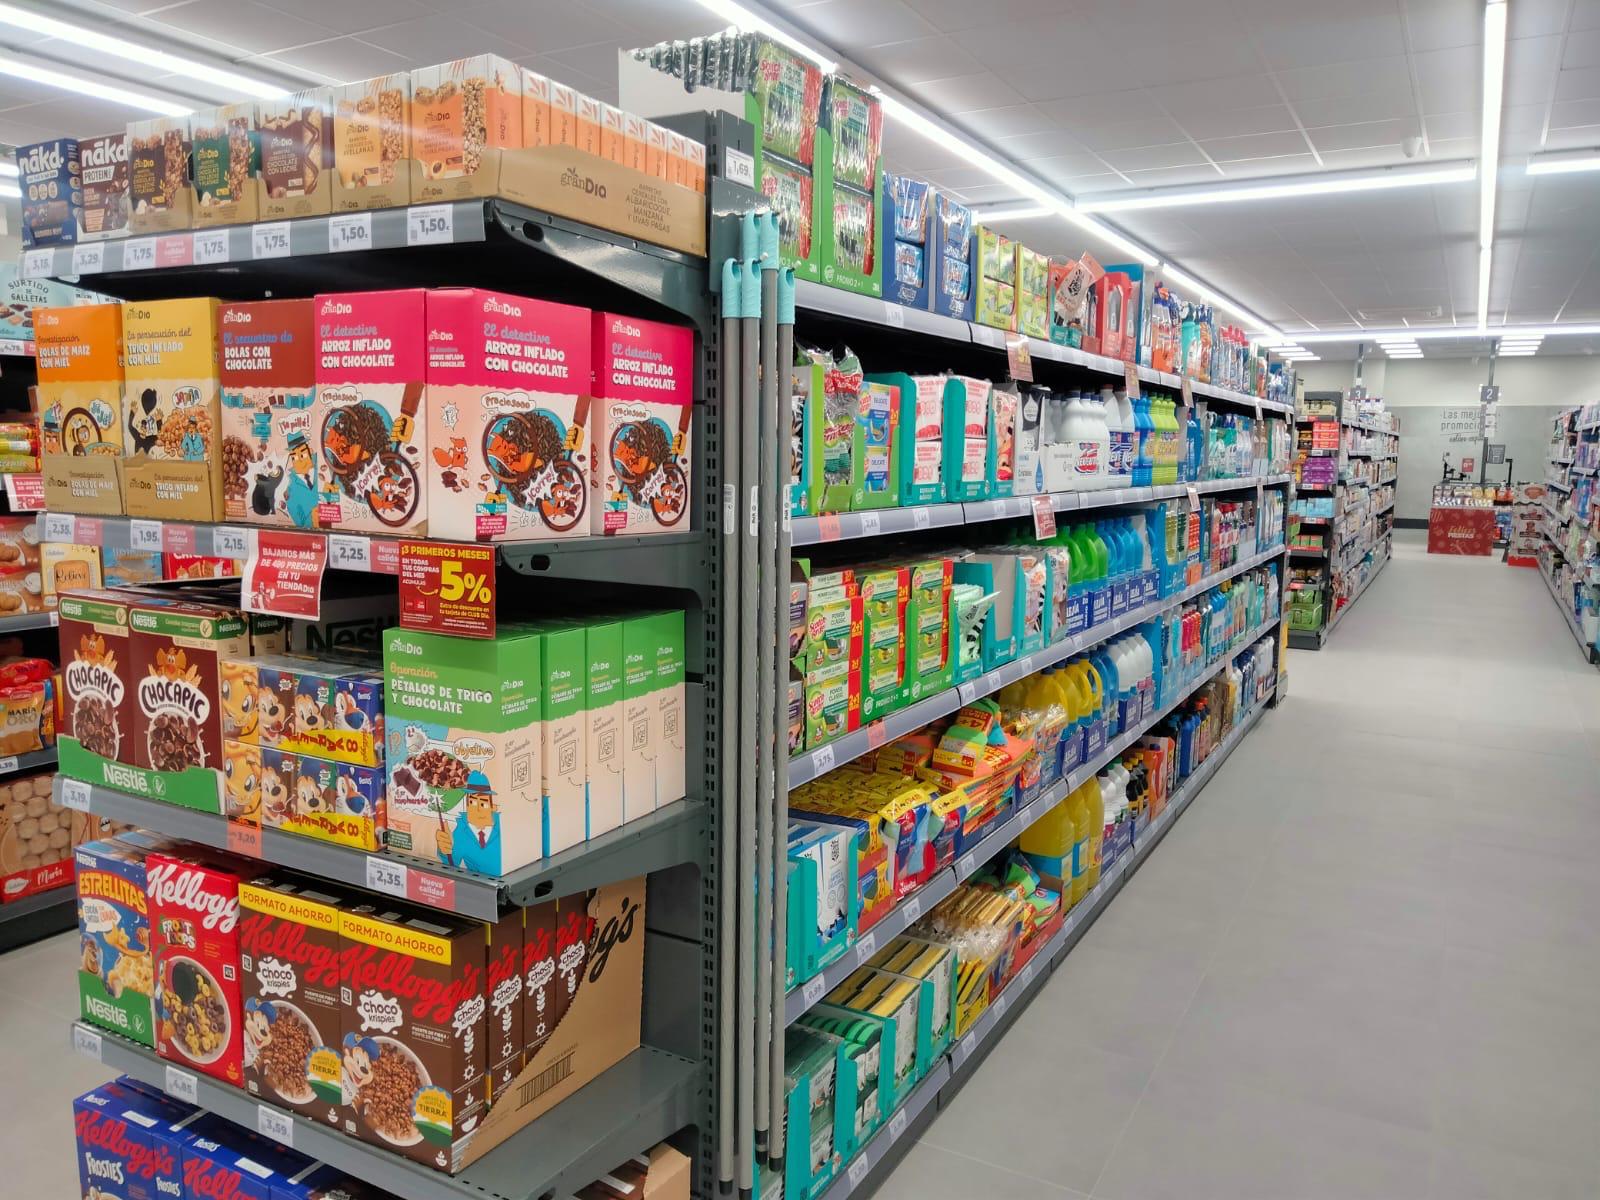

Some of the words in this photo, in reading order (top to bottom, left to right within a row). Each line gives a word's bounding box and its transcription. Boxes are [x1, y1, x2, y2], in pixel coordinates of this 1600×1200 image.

[634, 206, 663, 222] MANZANA
[633, 214, 650, 226] UVAS
[651, 219, 671, 233] PASAS
[8, 279, 49, 295] SURTIDO
[11, 293, 48, 303] GALLETAS
[334, 325, 377, 336] detective
[501, 326, 551, 345] detective
[128, 343, 148, 355] TRIGO
[149, 341, 183, 352] INFLADO
[225, 346, 250, 358] BOLAS
[253, 346, 271, 358] CON
[322, 340, 350, 353] ARROZ
[352, 338, 391, 351] INFLADO
[485, 340, 521, 357] ARROZ
[524, 345, 565, 362] INFLADO
[128, 355, 143, 365] CON
[144, 354, 161, 365] MIEL
[322, 356, 340, 368] CON
[342, 354, 395, 367] CHOCOLATE
[625, 345, 662, 362] detective
[54, 357, 70, 368] MIEL
[226, 358, 273, 370] CHOCOLATE
[485, 357, 509, 372] CON
[512, 361, 568, 378] CHOCOLATE
[613, 358, 640, 372] ARROZ
[643, 362, 673, 377] INFLADO
[613, 373, 631, 386] CON
[633, 374, 676, 391] CHOCOLATE
[1486, 388, 1493, 400] 2
[262, 547, 298, 559] BAJAMOS
[299, 551, 316, 561] MÁS
[411, 546, 456, 558] PRIMEROS
[458, 549, 490, 561] MESES!
[260, 559, 271, 567] DE
[286, 561, 319, 572] PRECIOS
[411, 558, 429, 566] TODAS
[278, 571, 289, 579] EN
[290, 572, 301, 580] TU
[440, 560, 492, 604] 5%
[61, 602, 82, 616] Nestlé
[445, 609, 461, 617] tarjeta
[133, 613, 158, 629] Nestlé
[851, 620, 863, 632] 2+1
[69, 667, 121, 702] CHOCAPIC
[392, 676, 435, 695] PÉTALOS
[439, 686, 454, 699] DE
[457, 688, 492, 704] TRIGO
[142, 683, 205, 718] CHOCAPIC
[392, 693, 398, 705] Y
[401, 694, 463, 714] CHOCOLATE
[7, 706, 36, 716] MARÍA
[103, 763, 149, 794] Nestlé
[376, 871, 401, 886] 2,35
[420, 877, 443, 890] Nueva
[79, 871, 148, 915] ESTRELLITAS
[418, 883, 445, 897] calidad
[243, 890, 287, 914] FORMATO
[288, 904, 333, 925] AHORRO
[343, 920, 393, 944] FORMATO
[395, 935, 445, 956] AHORRO
[262, 966, 293, 981] choco
[531, 961, 553, 982] choco
[266, 978, 291, 989] krispies
[497, 979, 519, 1001] choco
[86, 997, 128, 1028] Nestlé
[363, 1000, 398, 1015] choco
[457, 999, 482, 1023] choco
[368, 1014, 396, 1025] krispies
[312, 1063, 338, 1077] TIERRA
[418, 1103, 447, 1118] TIERRA
